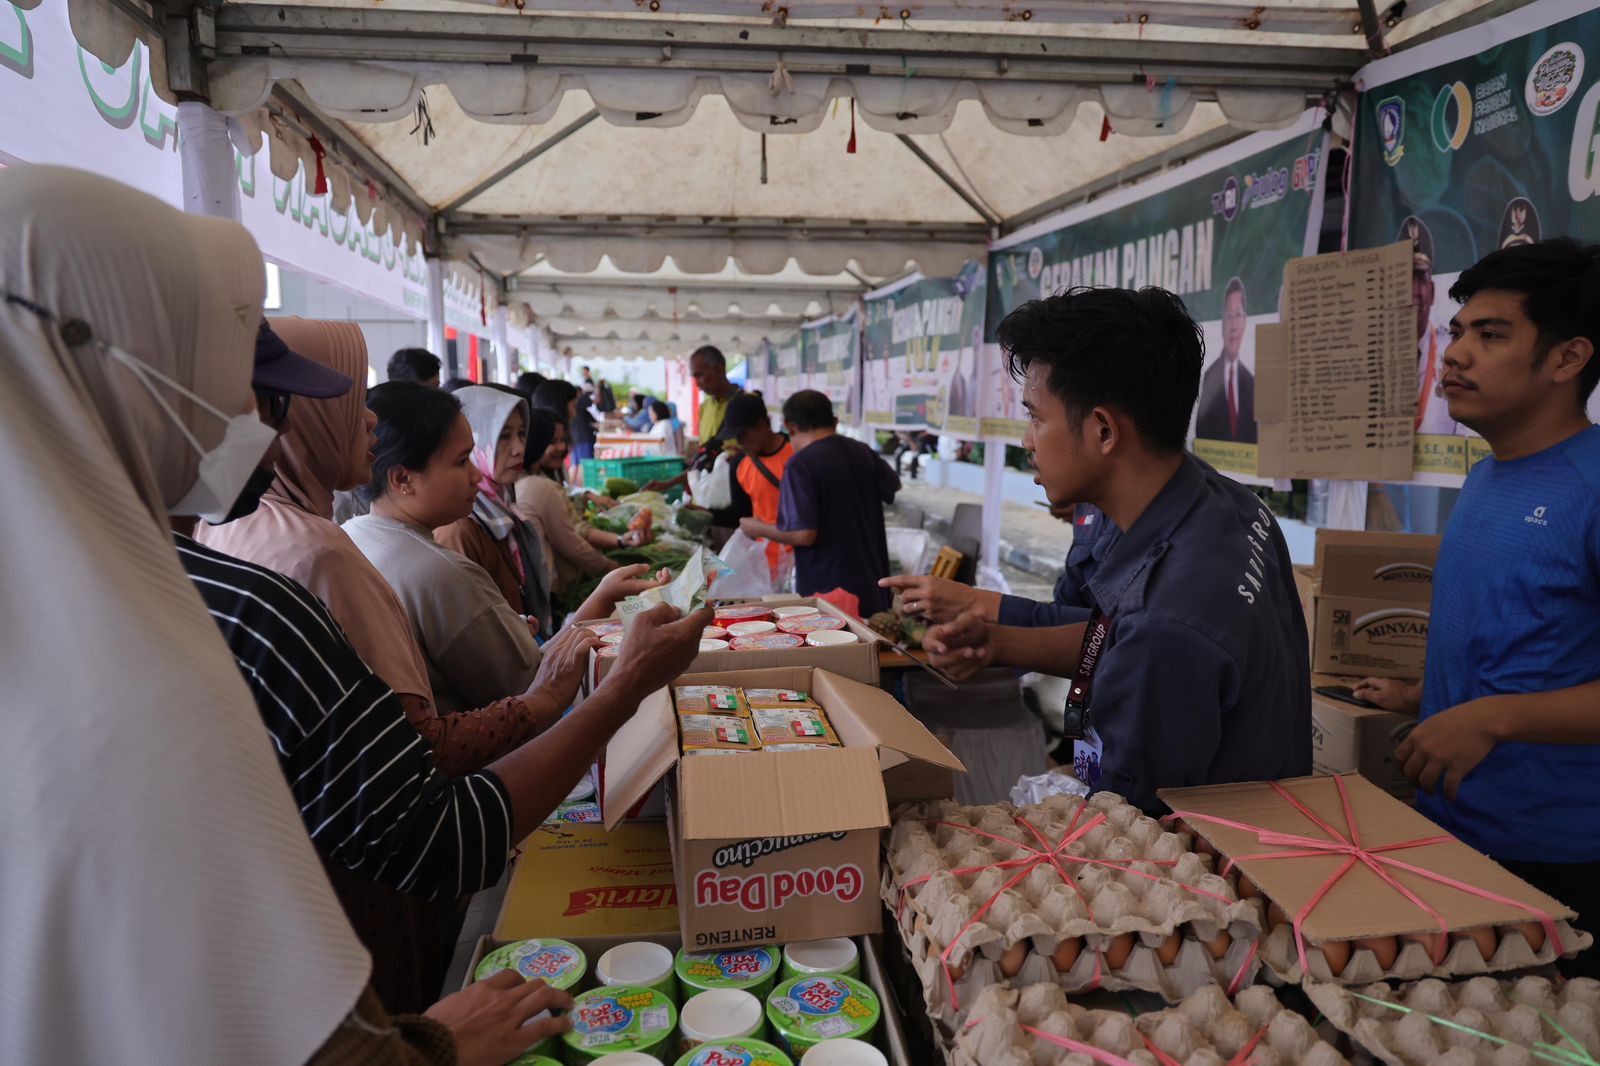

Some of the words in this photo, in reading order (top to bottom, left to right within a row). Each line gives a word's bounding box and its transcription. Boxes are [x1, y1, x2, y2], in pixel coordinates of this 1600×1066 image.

[1122, 218, 1214, 294] PANGAN
[621, 600, 644, 612] 2000
[697, 871, 767, 912] Day
[772, 866, 862, 909] Good
[695, 926, 776, 947] RENTENG
[527, 952, 555, 974] MIE
[547, 953, 572, 974] POP
[721, 953, 757, 966] MIE
[728, 961, 760, 974] POP
[799, 989, 838, 1011] MIE
[810, 980, 843, 999] POP
[577, 1002, 612, 1022] POP
[587, 1010, 626, 1030] MIE
